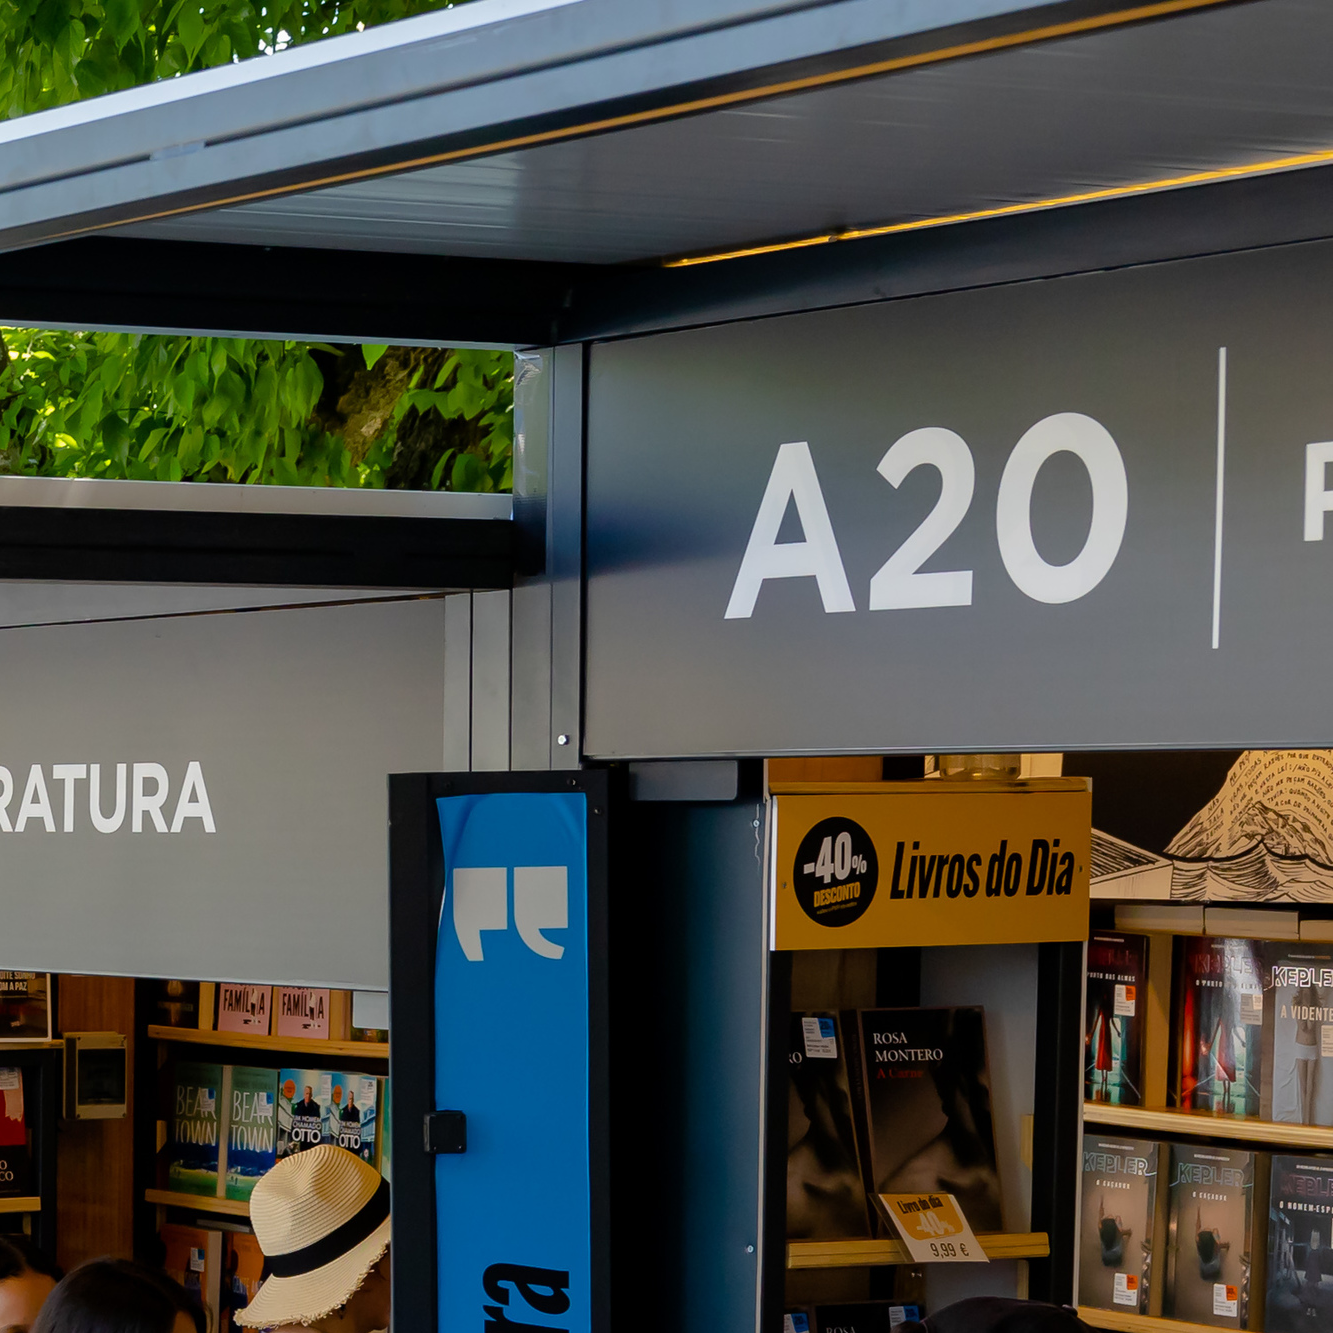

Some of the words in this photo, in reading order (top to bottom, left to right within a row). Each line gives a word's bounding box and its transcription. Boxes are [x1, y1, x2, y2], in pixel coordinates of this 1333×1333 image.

[724, 412, 1128, 619] A20
[803, 831, 867, 884] -40%
[890, 840, 982, 899] Livros
[985, 839, 1023, 898] do
[1025, 838, 1075, 896] Dia
[813, 881, 861, 907] DESCONTO
[9, 982, 14, 991] A
[14, 981, 28, 991] PAZ
[223, 988, 265, 1016] FAMÍLA
[283, 991, 324, 1019] FAMÍLA
[1280, 1005, 1287, 1018] A
[873, 1032, 908, 1044] ROSA
[875, 1048, 943, 1063] MONTERO
[877, 1068, 886, 1079] A
[175, 1119, 217, 1146] TOWN
[231, 1124, 274, 1153] TOWN
[291, 1128, 321, 1143] OTTO
[338, 1134, 361, 1149] OTTO
[1083, 1152, 1153, 1177] KEPLER
[1175, 1163, 1248, 1188] KEPLER
[897, 1197, 921, 1214] Livro
[930, 1242, 956, 1257] 9,99
[960, 1243, 970, 1257] €
